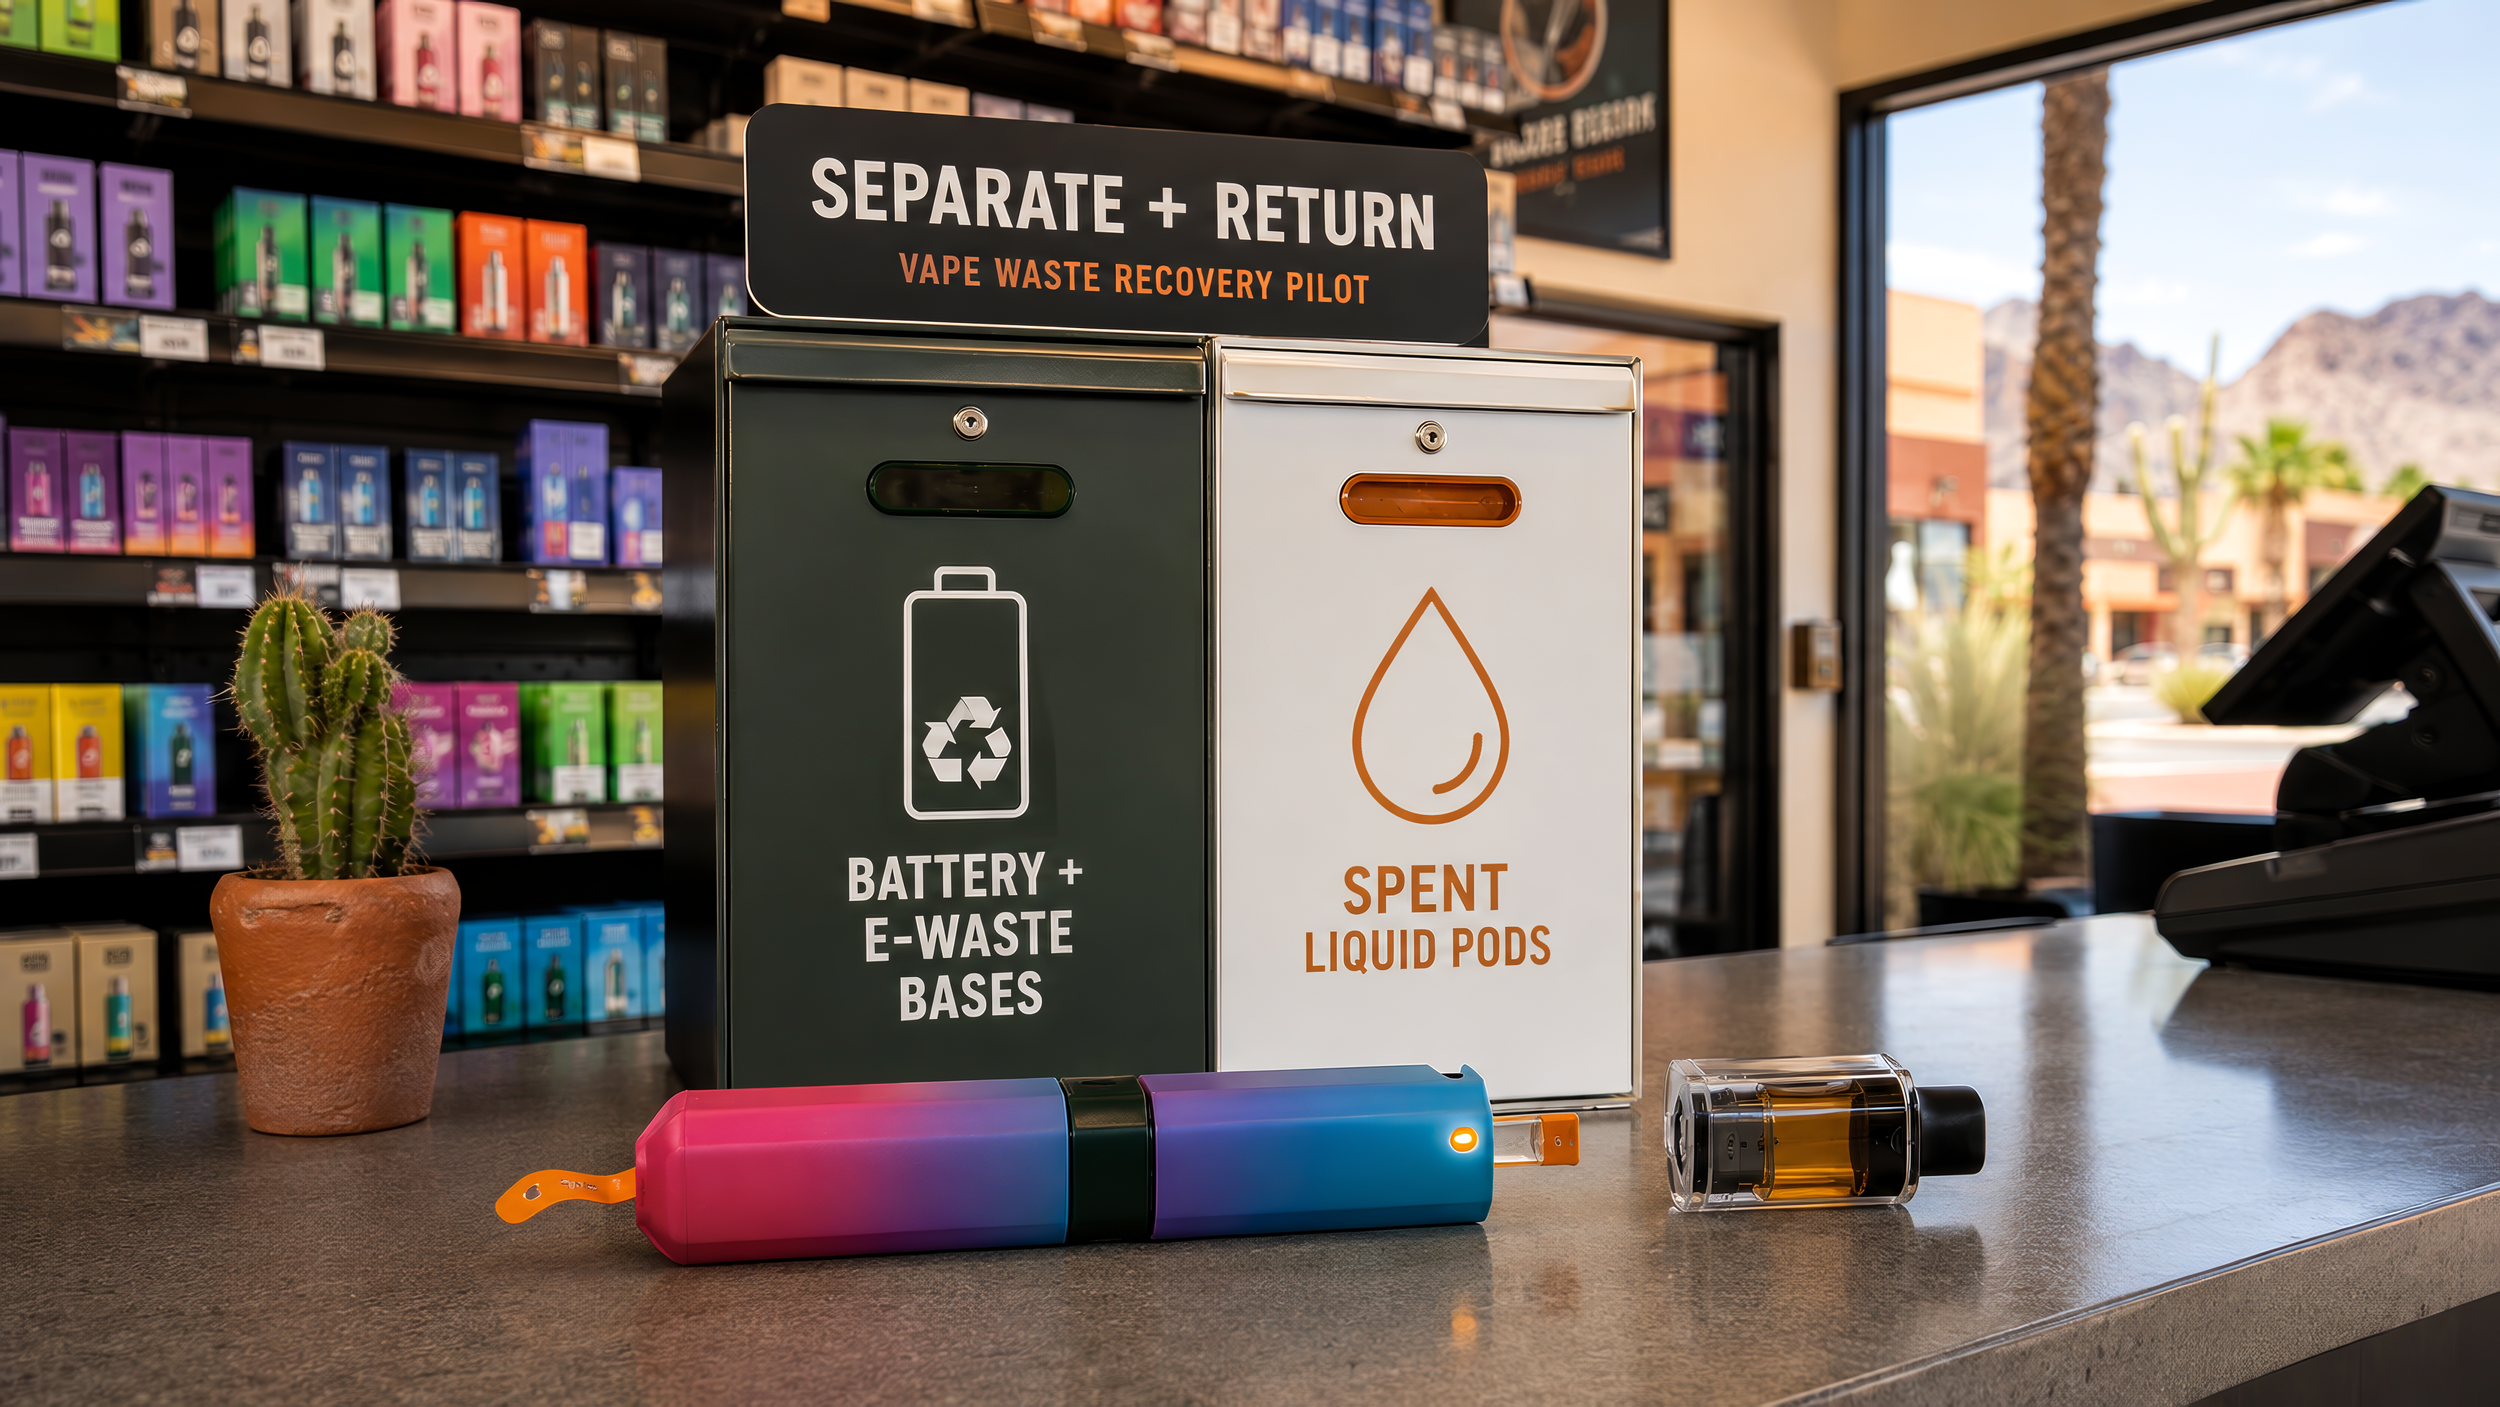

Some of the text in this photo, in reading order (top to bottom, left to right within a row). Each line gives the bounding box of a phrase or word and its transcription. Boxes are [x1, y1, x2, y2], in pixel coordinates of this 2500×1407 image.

[811, 157, 1435, 251] SEPARATE + RETURN
[898, 252, 1370, 305] VAPE WASTE RECOVERY PILOT
[848, 851, 1083, 902] BATTERY +
[1343, 862, 1509, 916] SPENT
[865, 909, 1073, 963] E-WASTE
[1305, 924, 1551, 975] LIQUID PODS
[899, 970, 1043, 1022] BASES
